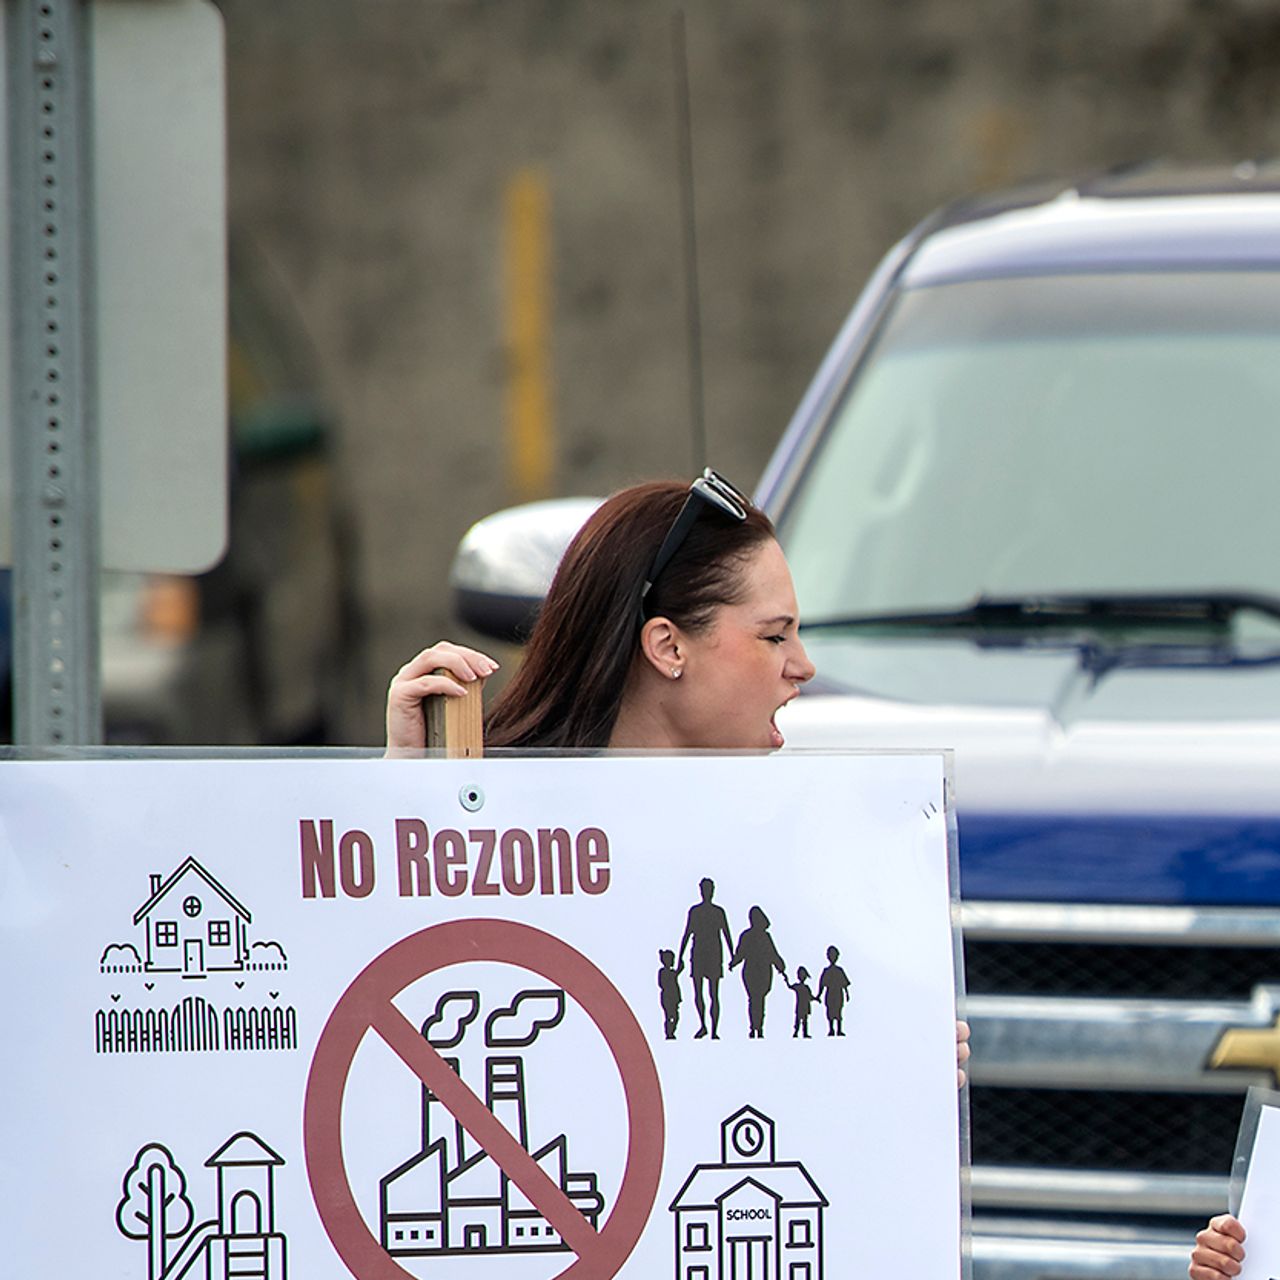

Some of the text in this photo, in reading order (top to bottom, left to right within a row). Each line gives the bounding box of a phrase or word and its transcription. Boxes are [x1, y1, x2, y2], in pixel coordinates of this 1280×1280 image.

[298, 818, 609, 899] No Rezone
[726, 1208, 773, 1221] SCHOOL
